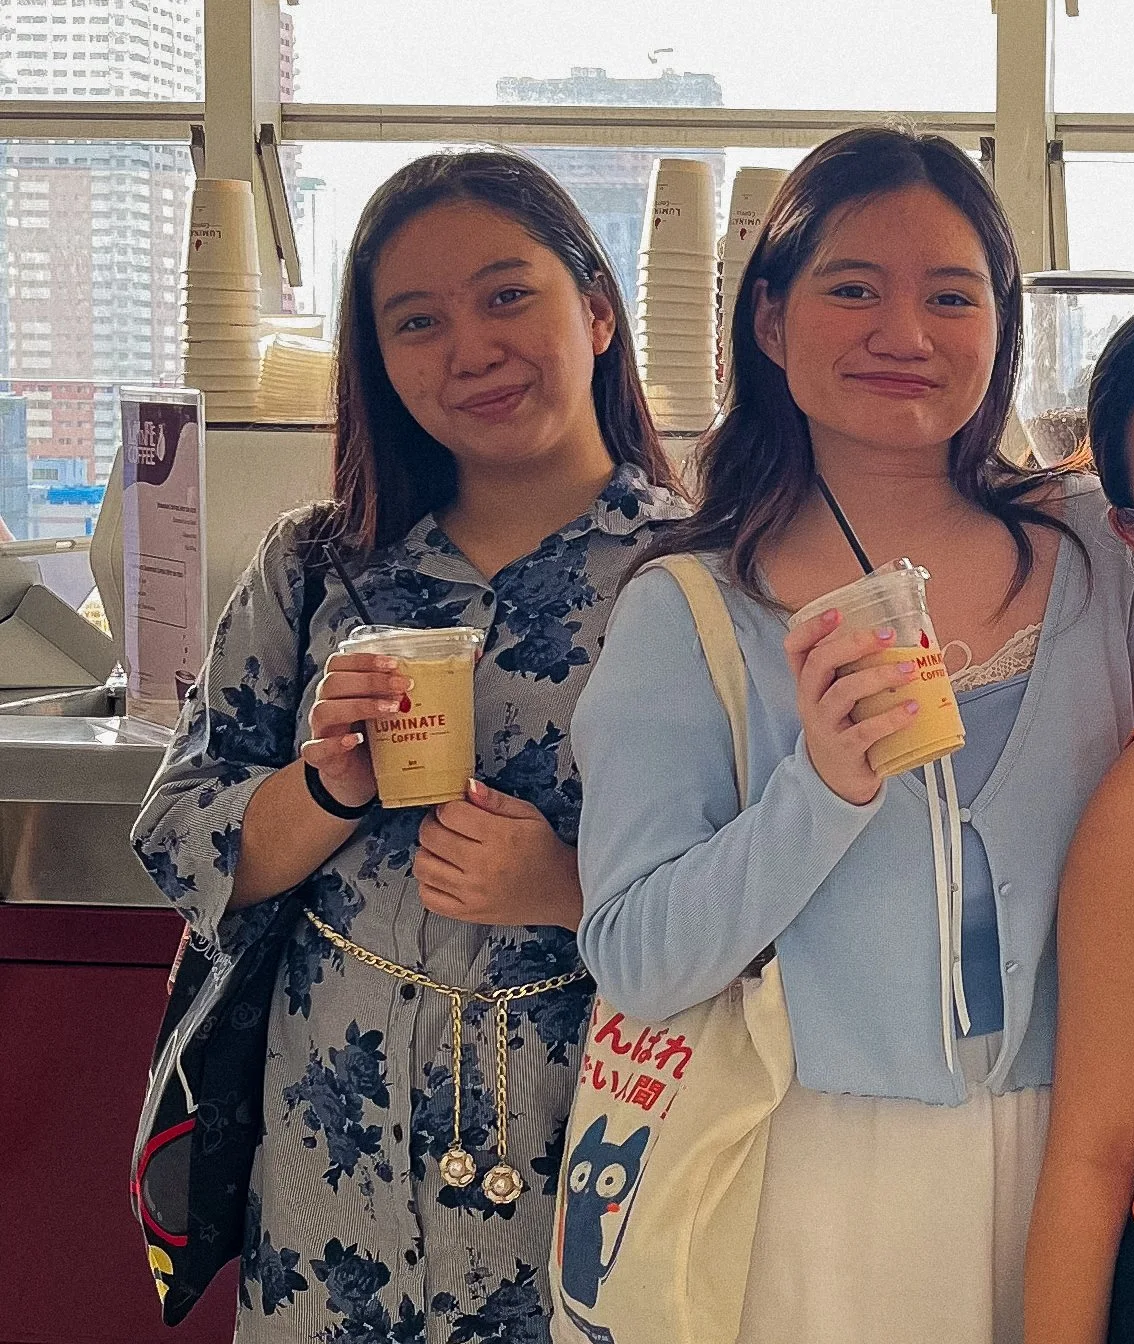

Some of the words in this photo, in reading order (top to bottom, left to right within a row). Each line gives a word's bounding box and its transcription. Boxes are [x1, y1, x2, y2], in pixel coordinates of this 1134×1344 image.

[374, 714, 446, 733] LUMINATE
[391, 732, 428, 743] COFFEE
[593, 999, 693, 1079] んばれ
